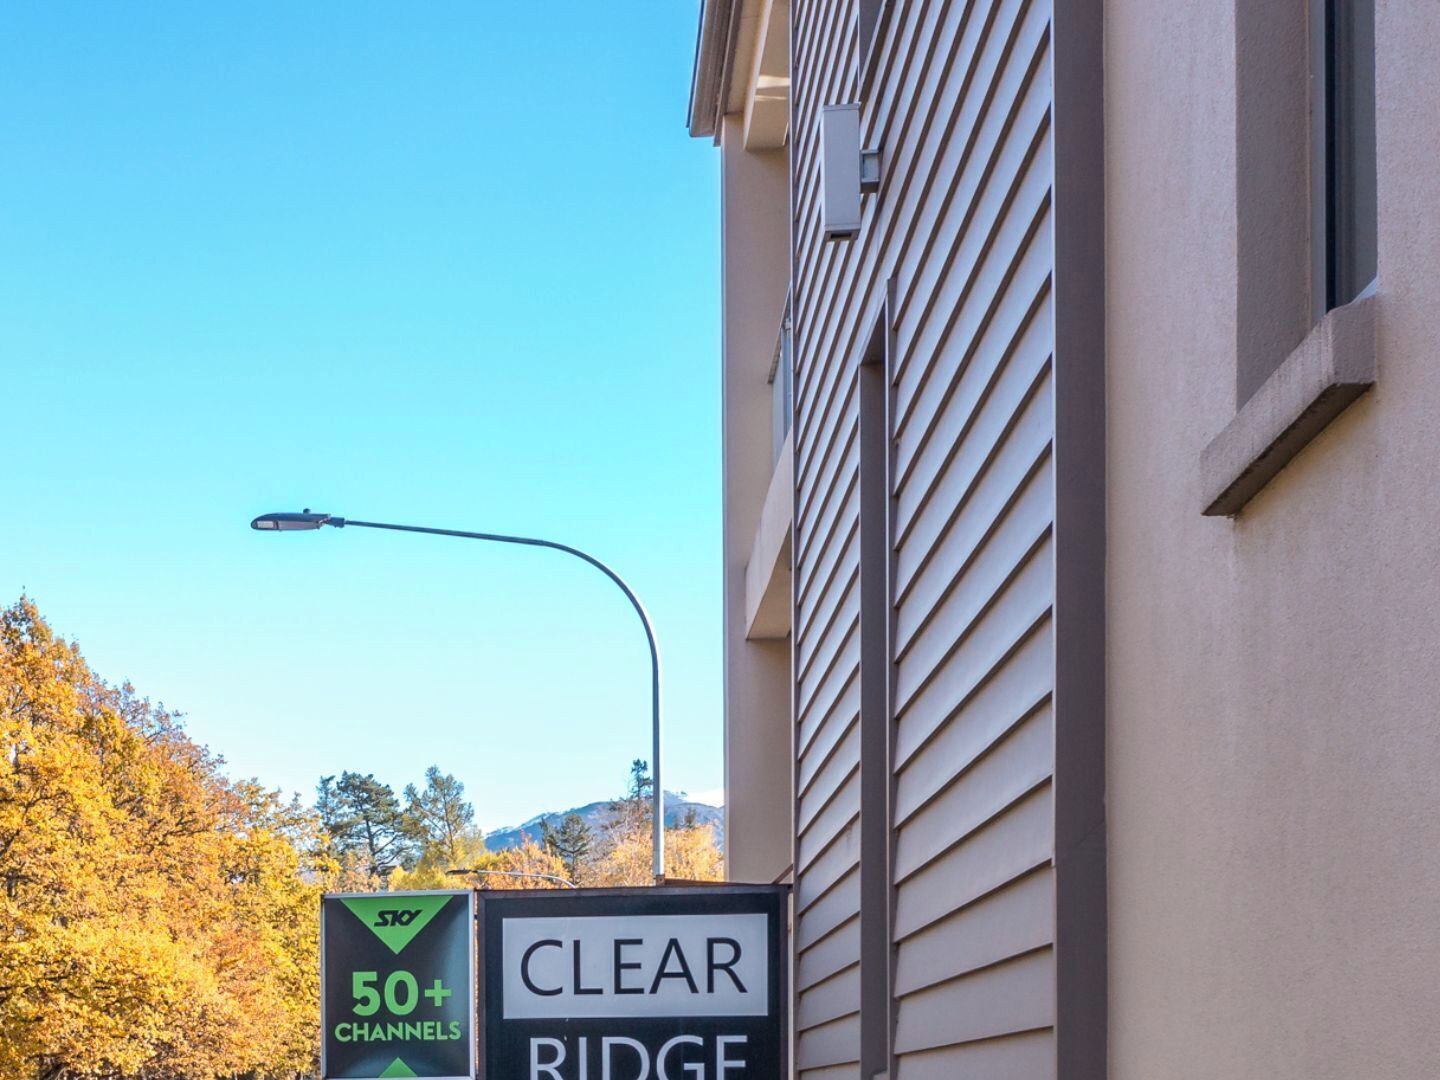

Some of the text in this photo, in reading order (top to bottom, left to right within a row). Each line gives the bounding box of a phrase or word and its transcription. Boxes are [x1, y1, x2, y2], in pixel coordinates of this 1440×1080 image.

[374, 909, 423, 927] SKY
[520, 938, 748, 996] CLEAR
[352, 970, 452, 1016] 50+
[335, 1021, 461, 1042] CHANNELS
